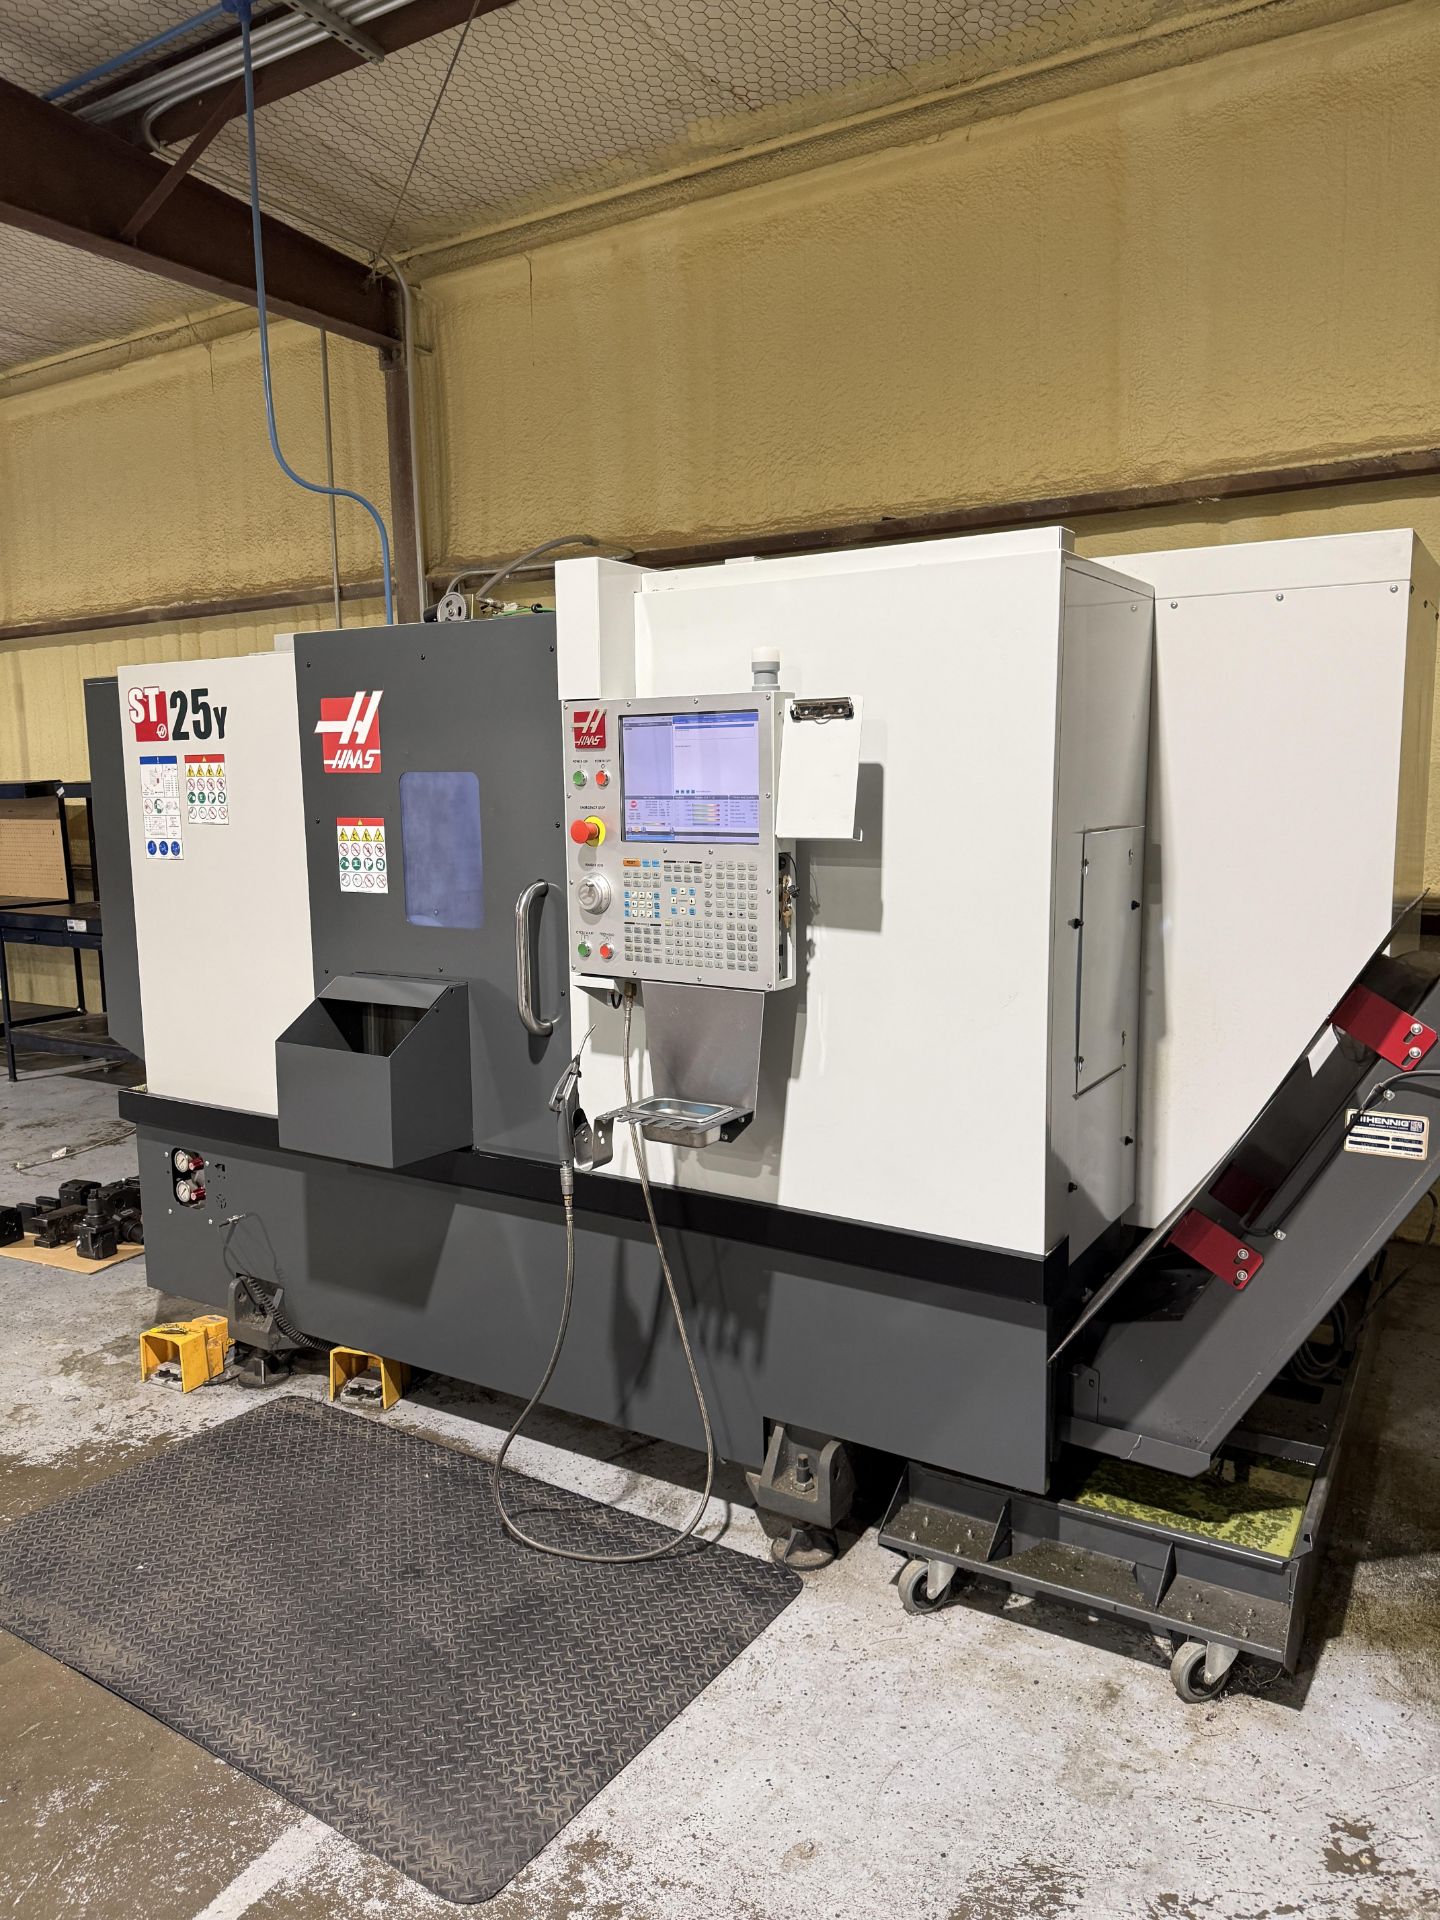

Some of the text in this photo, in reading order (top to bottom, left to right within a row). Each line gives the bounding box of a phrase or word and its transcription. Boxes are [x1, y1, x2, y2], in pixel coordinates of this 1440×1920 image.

[128, 686, 160, 724] ST
[323, 749, 382, 770] HAAS
[1366, 1115, 1409, 1127] HENNIG
